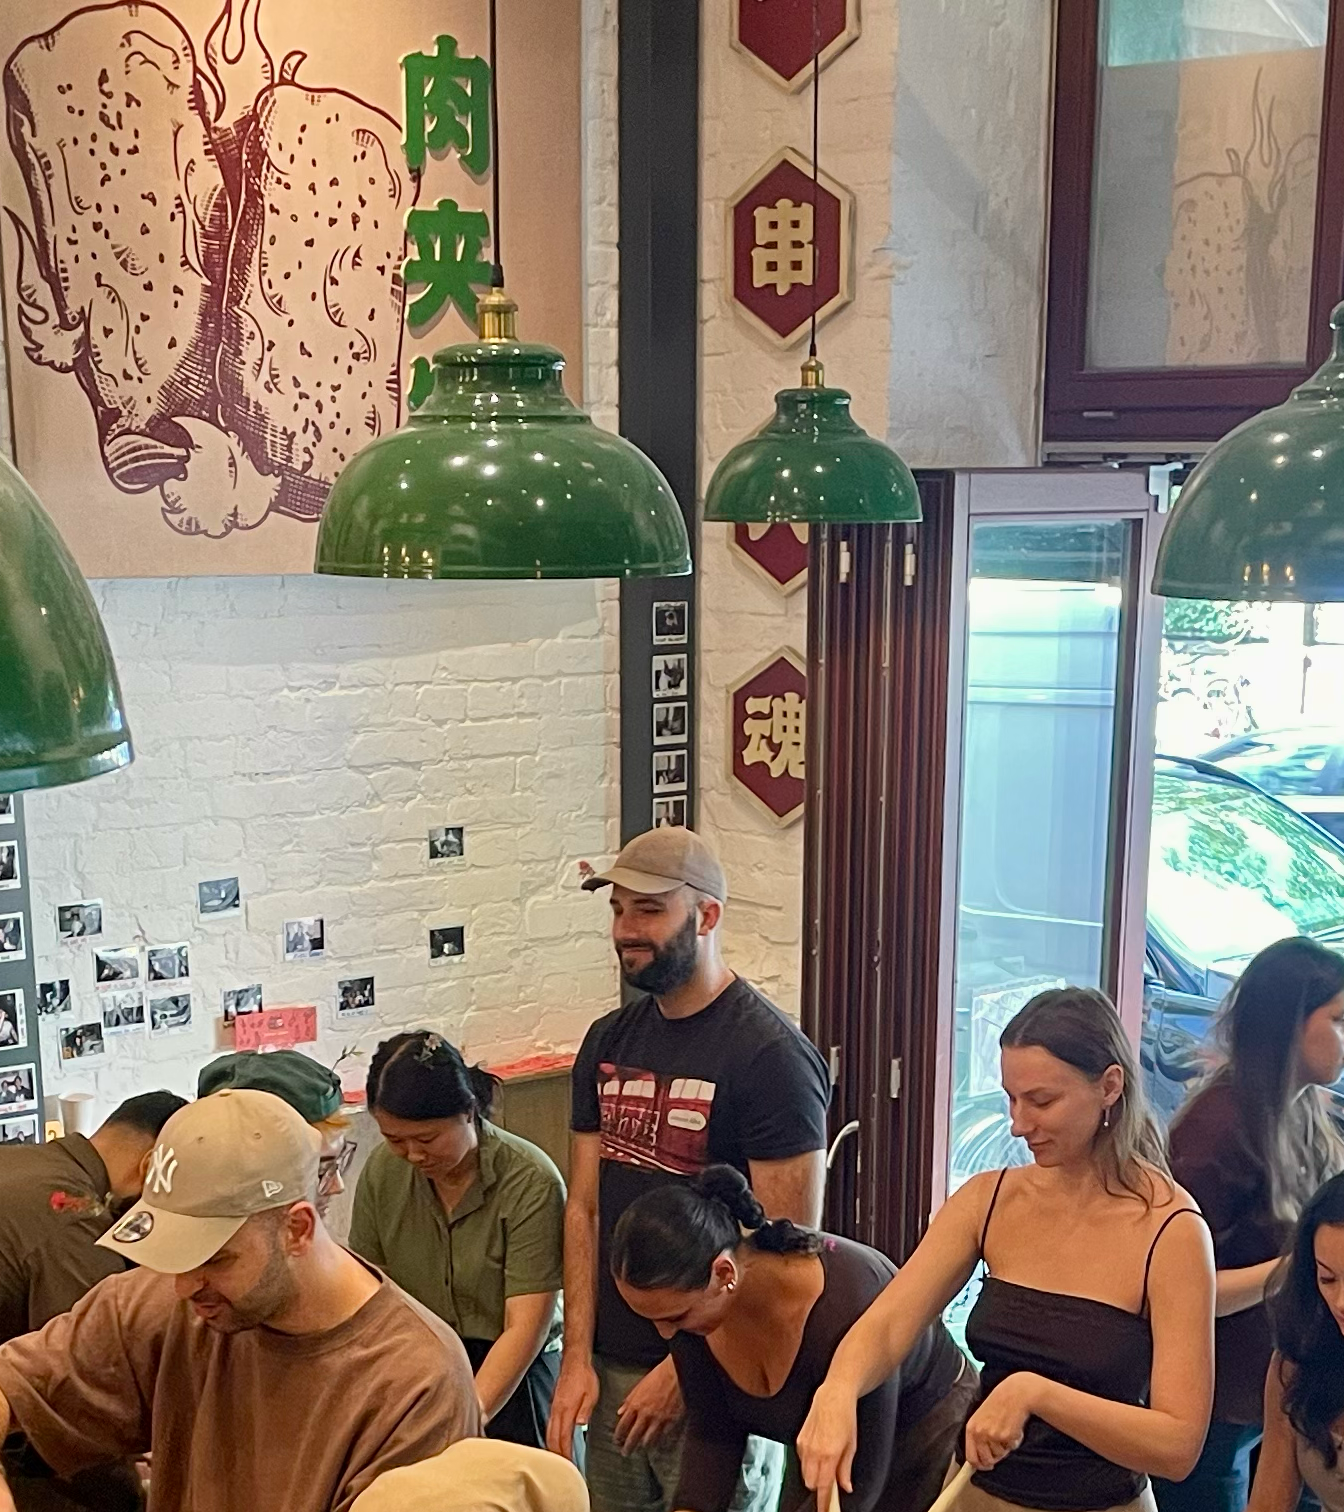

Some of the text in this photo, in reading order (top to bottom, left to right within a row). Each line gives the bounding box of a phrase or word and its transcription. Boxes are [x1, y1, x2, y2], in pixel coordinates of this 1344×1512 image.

[399, 33, 494, 412] 肉夹
[750, 197, 815, 297] 串
[145, 1143, 178, 1194] NY
